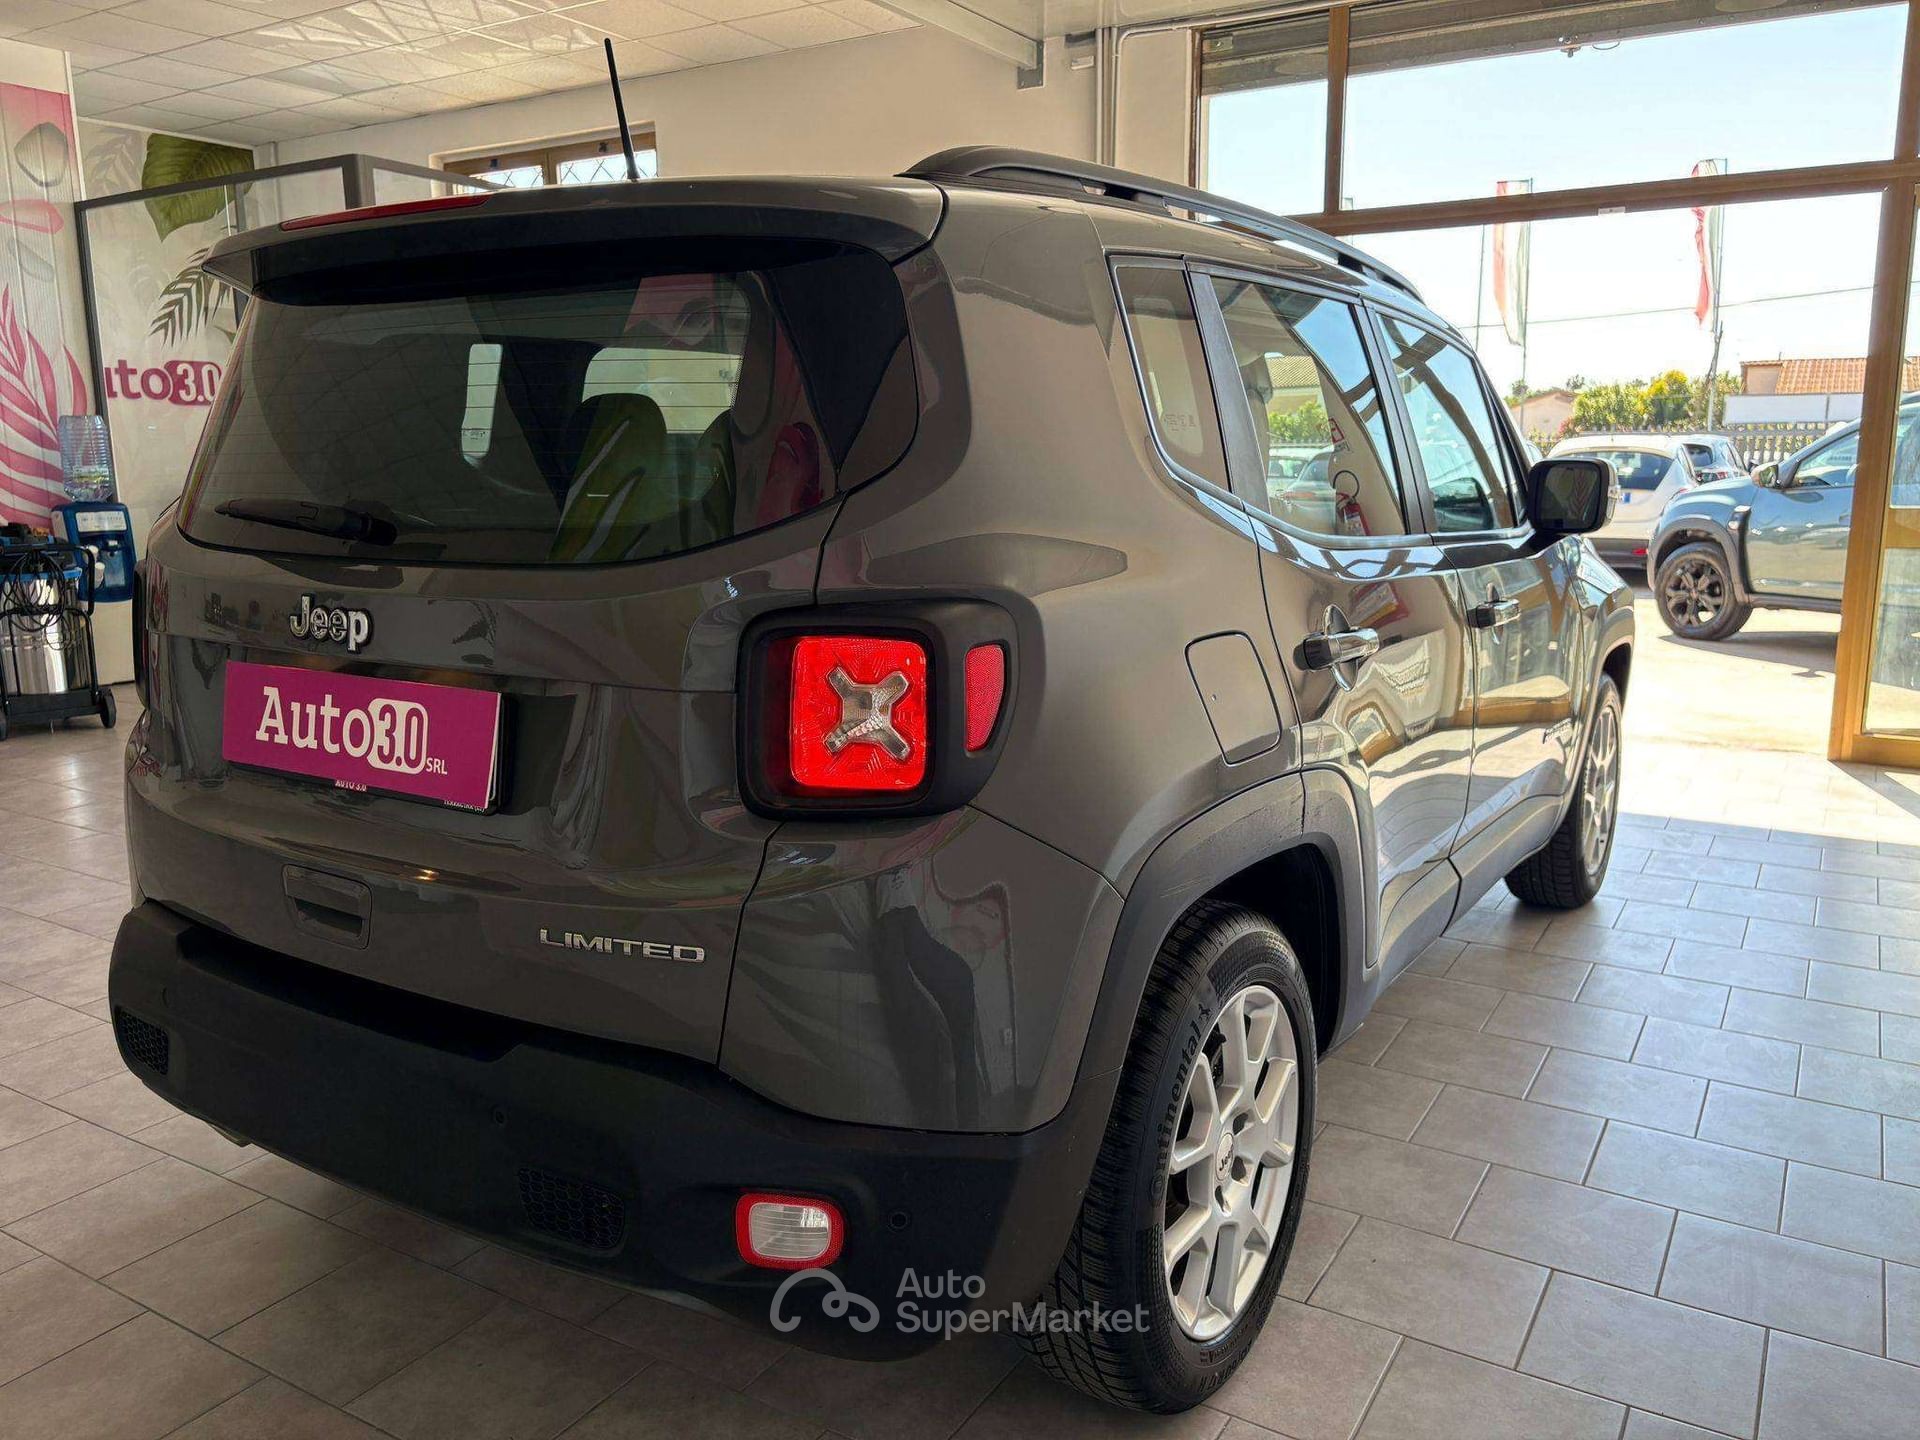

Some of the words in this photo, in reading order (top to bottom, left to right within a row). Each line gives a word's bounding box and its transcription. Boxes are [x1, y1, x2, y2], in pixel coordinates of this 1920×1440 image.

[289, 594, 372, 652] Jeep
[425, 757, 448, 775] SRL
[539, 928, 705, 963] LIMITED
